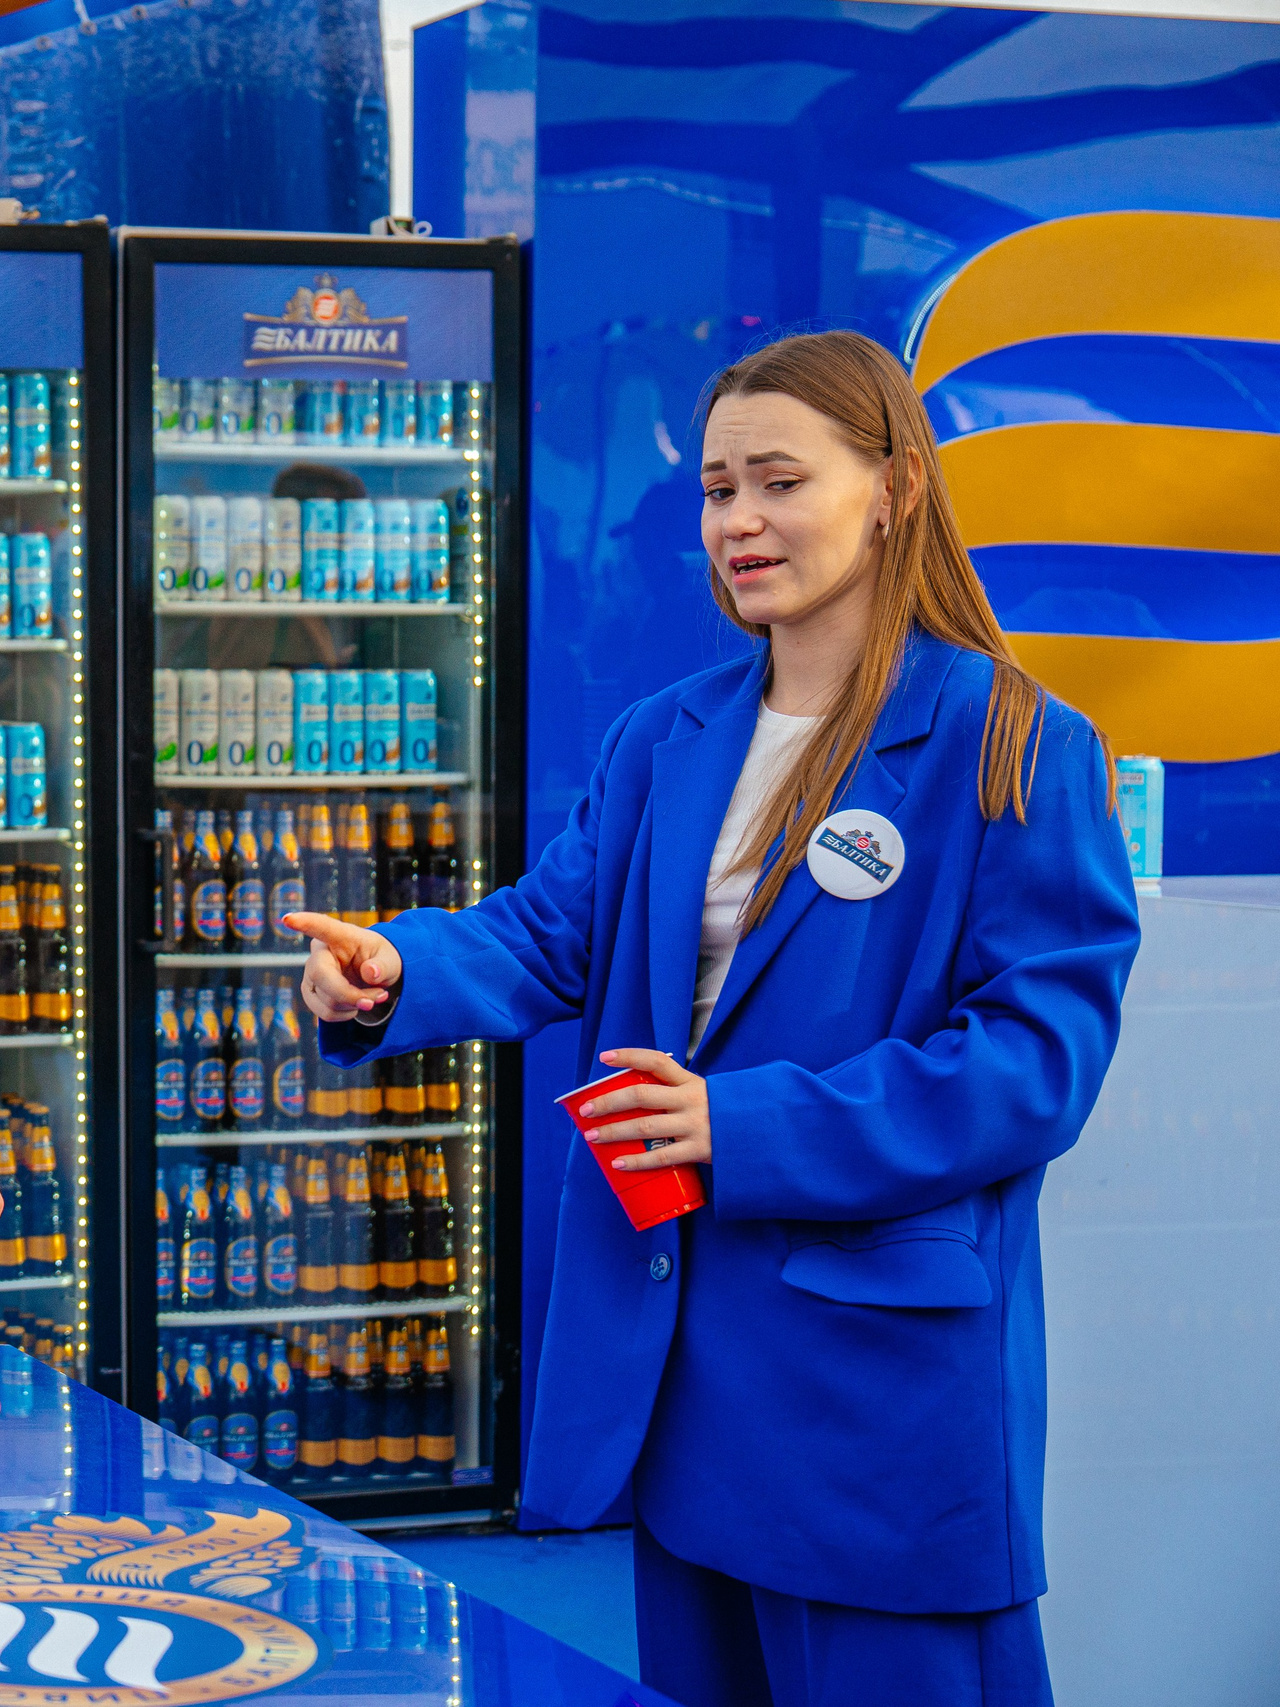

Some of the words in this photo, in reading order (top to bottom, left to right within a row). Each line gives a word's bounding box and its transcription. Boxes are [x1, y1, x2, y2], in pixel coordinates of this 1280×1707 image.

[273, 327, 399, 354] БАЛТИКА
[187, 740, 203, 766] 0
[229, 740, 246, 766] 0
[267, 740, 284, 766] 0
[308, 740, 323, 766] 0
[340, 740, 355, 766] 0
[370, 740, 386, 766] 0
[413, 740, 429, 766] 0
[831, 839, 888, 877] БАЛТИКА
[151, 1537, 238, 1561] 1990
